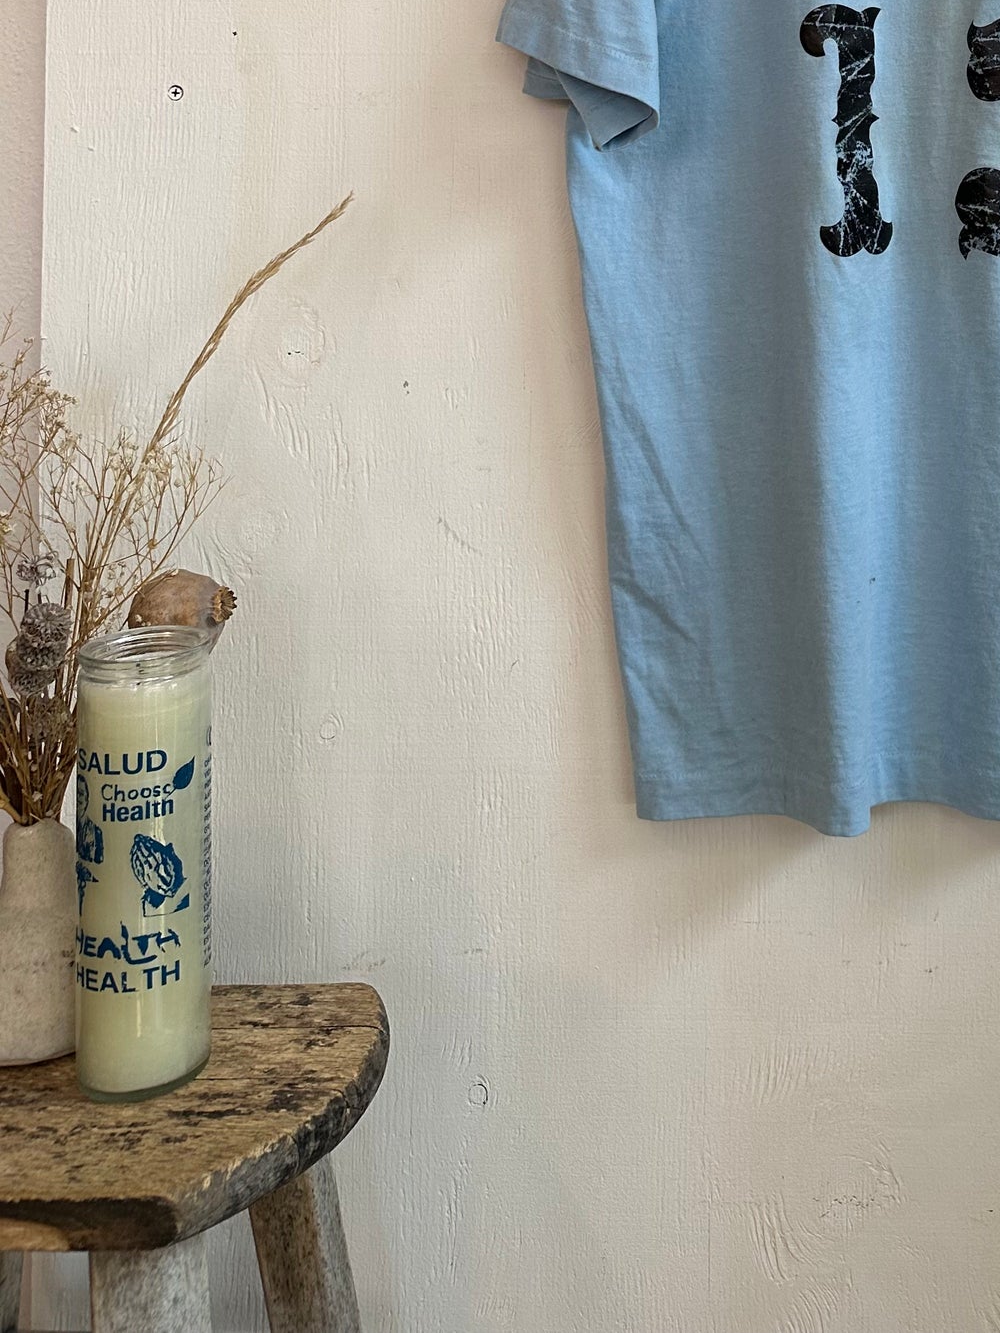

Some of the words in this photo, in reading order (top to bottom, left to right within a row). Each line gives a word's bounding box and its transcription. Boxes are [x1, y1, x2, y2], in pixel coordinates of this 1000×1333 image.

[78, 748, 167, 775] SALUD
[102, 798, 174, 822] Health
[76, 921, 181, 965] HEALTH
